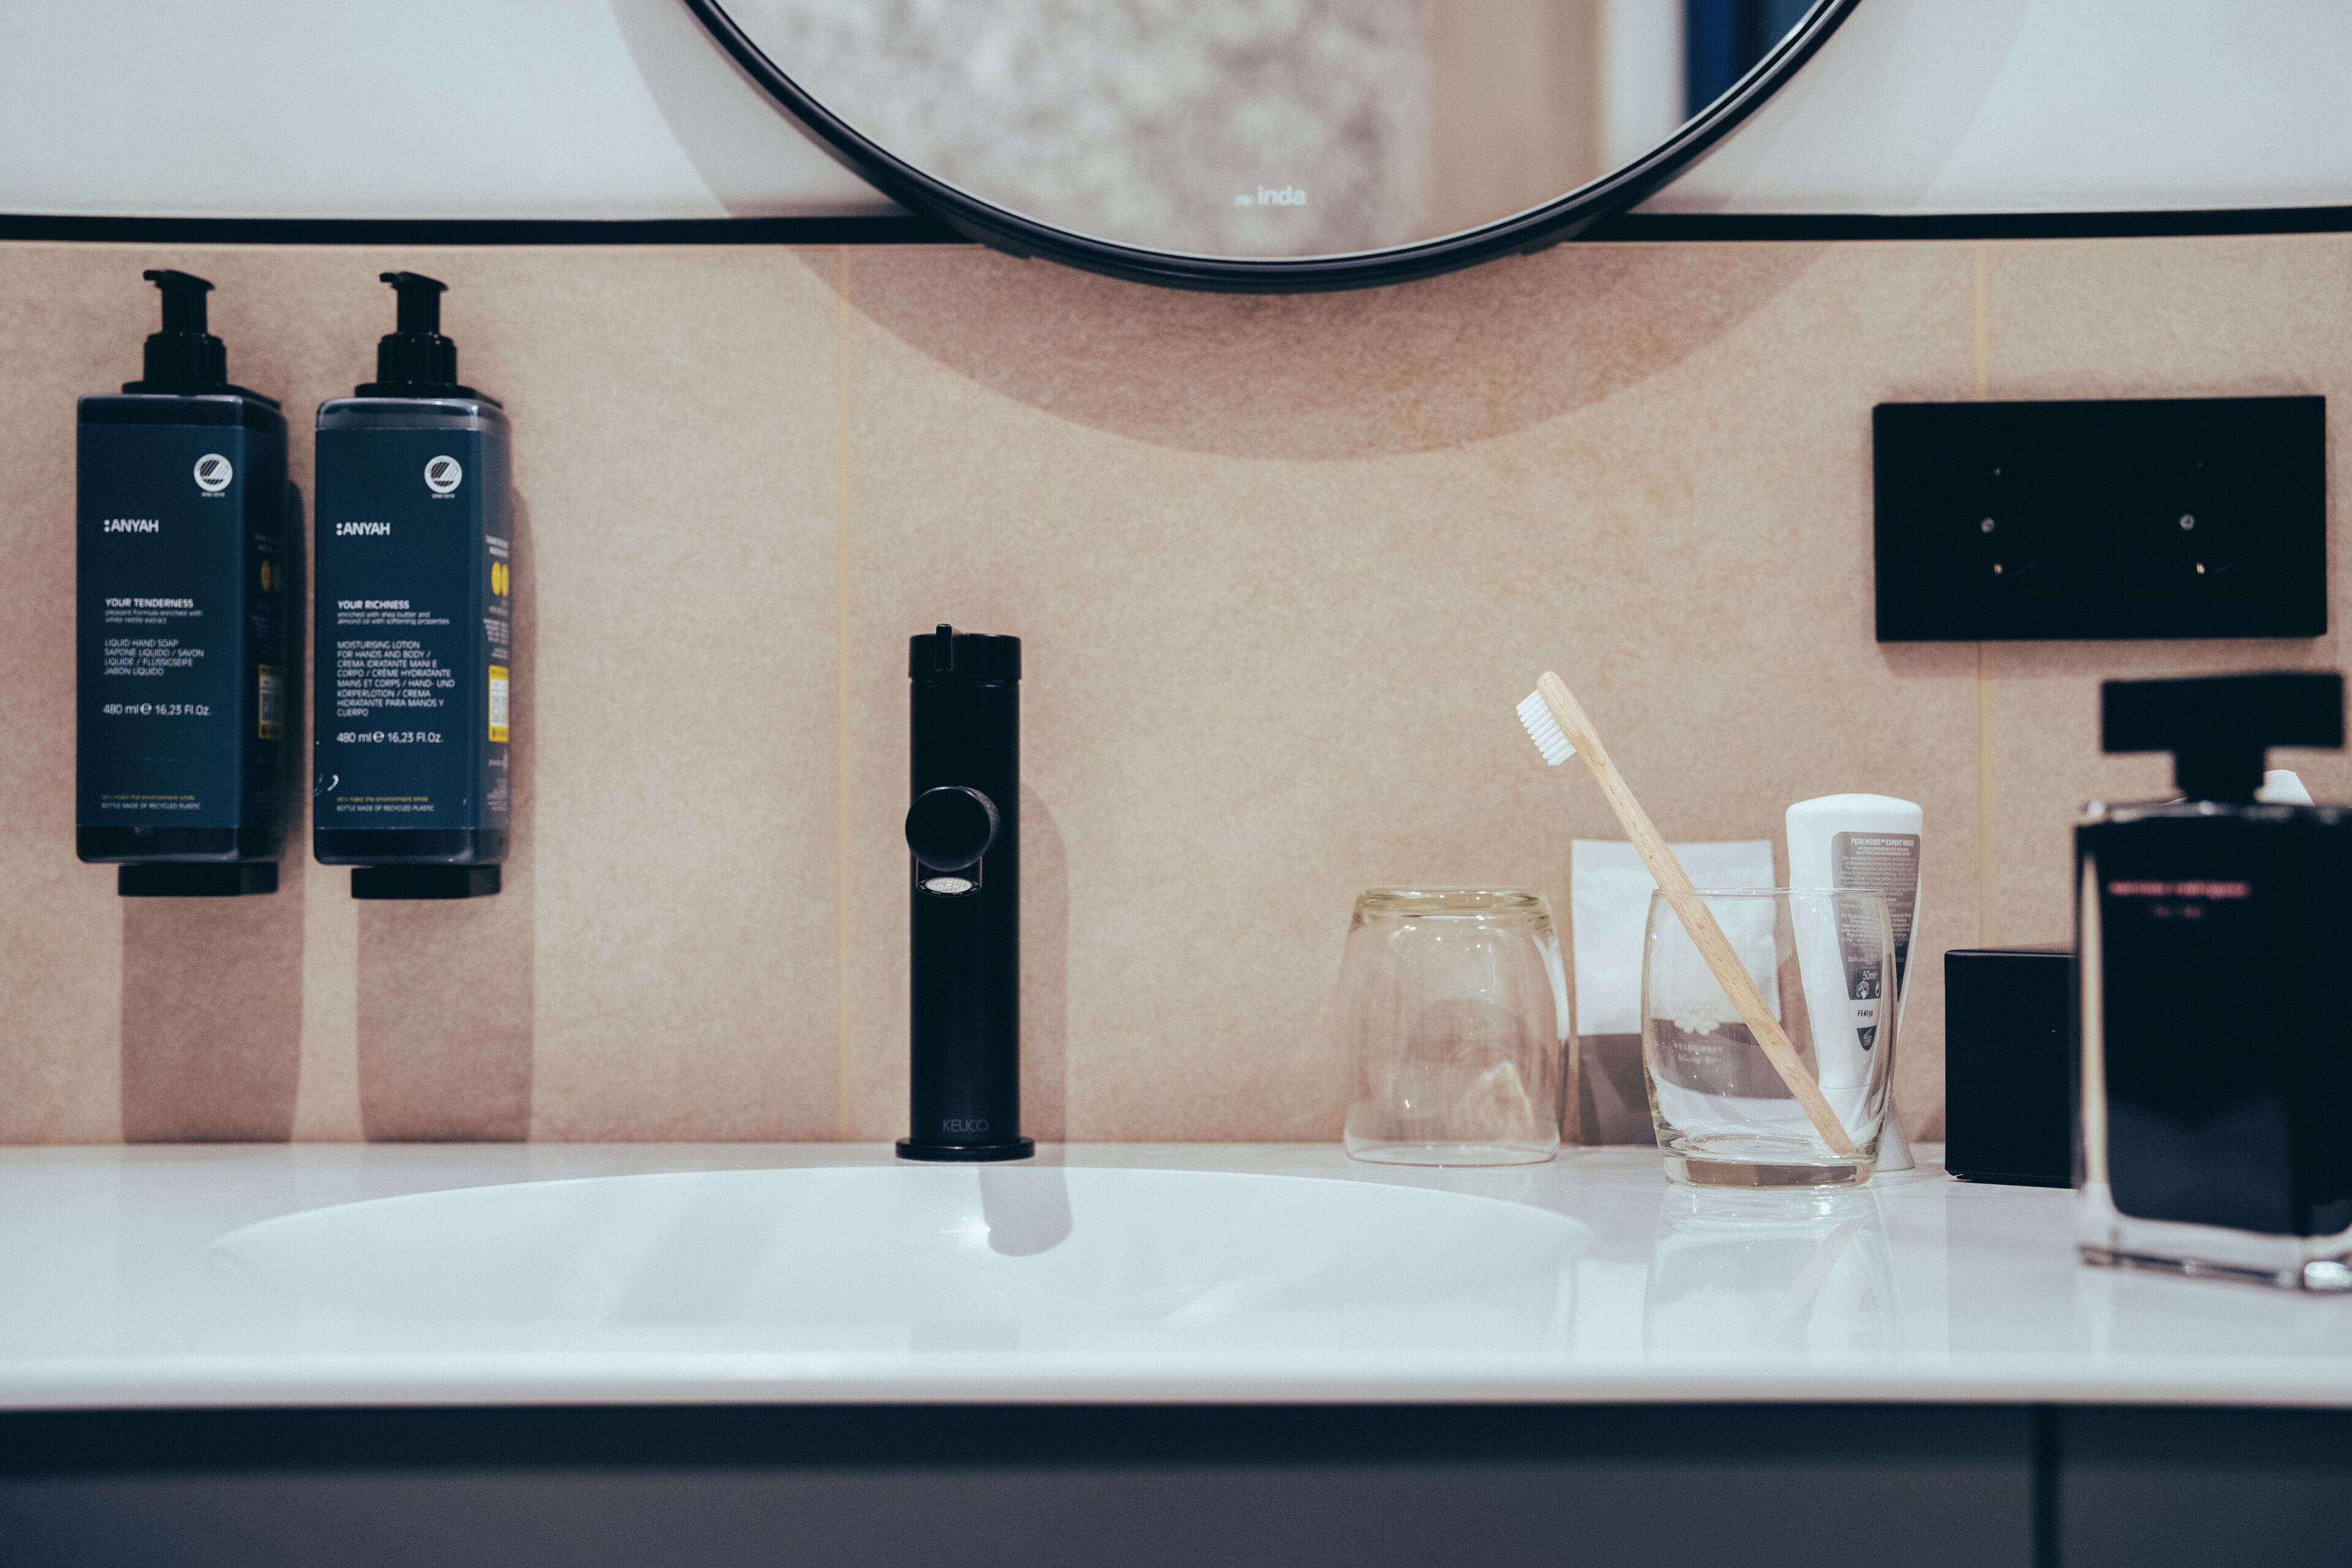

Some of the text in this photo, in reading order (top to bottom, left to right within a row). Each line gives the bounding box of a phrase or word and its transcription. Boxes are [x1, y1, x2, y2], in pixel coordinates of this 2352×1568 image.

[1257, 185, 1307, 206] inda
[105, 598, 194, 608] YOUR TENDERNESS
[337, 600, 410, 609] YOUR RICHNESS
[105, 638, 178, 648] LIQUID HAND SOAP
[392, 640, 420, 649] LOTION
[104, 648, 136, 657] SAPONE
[138, 648, 170, 657] LIQUIDO
[178, 648, 204, 657] SAVON
[337, 650, 353, 658] FOR
[355, 650, 382, 658] HANDS
[383, 650, 401, 658] AND
[402, 650, 424, 658] BODY
[104, 657, 134, 667] LIQUIDE
[337, 659, 437, 668] CREMA IDRATANTE MANI E
[133, 666, 164, 676] LIQUIDO
[337, 668, 364, 678] CORPO
[401, 668, 451, 678] HYDRATANTE
[337, 679, 362, 688] MAINS
[363, 679, 372, 688] ET
[374, 679, 401, 688] CORPS
[437, 679, 455, 688] UND
[402, 688, 431, 698] CREMA
[337, 698, 444, 707] HIDRATANTE PARA MANOS Y
[103, 704, 123, 715] 480
[124, 704, 138, 715] ml
[337, 708, 369, 717] CUERPO
[336, 732, 356, 743] 480
[358, 732, 371, 743] ml
[942, 1119, 990, 1132] KEUCO
